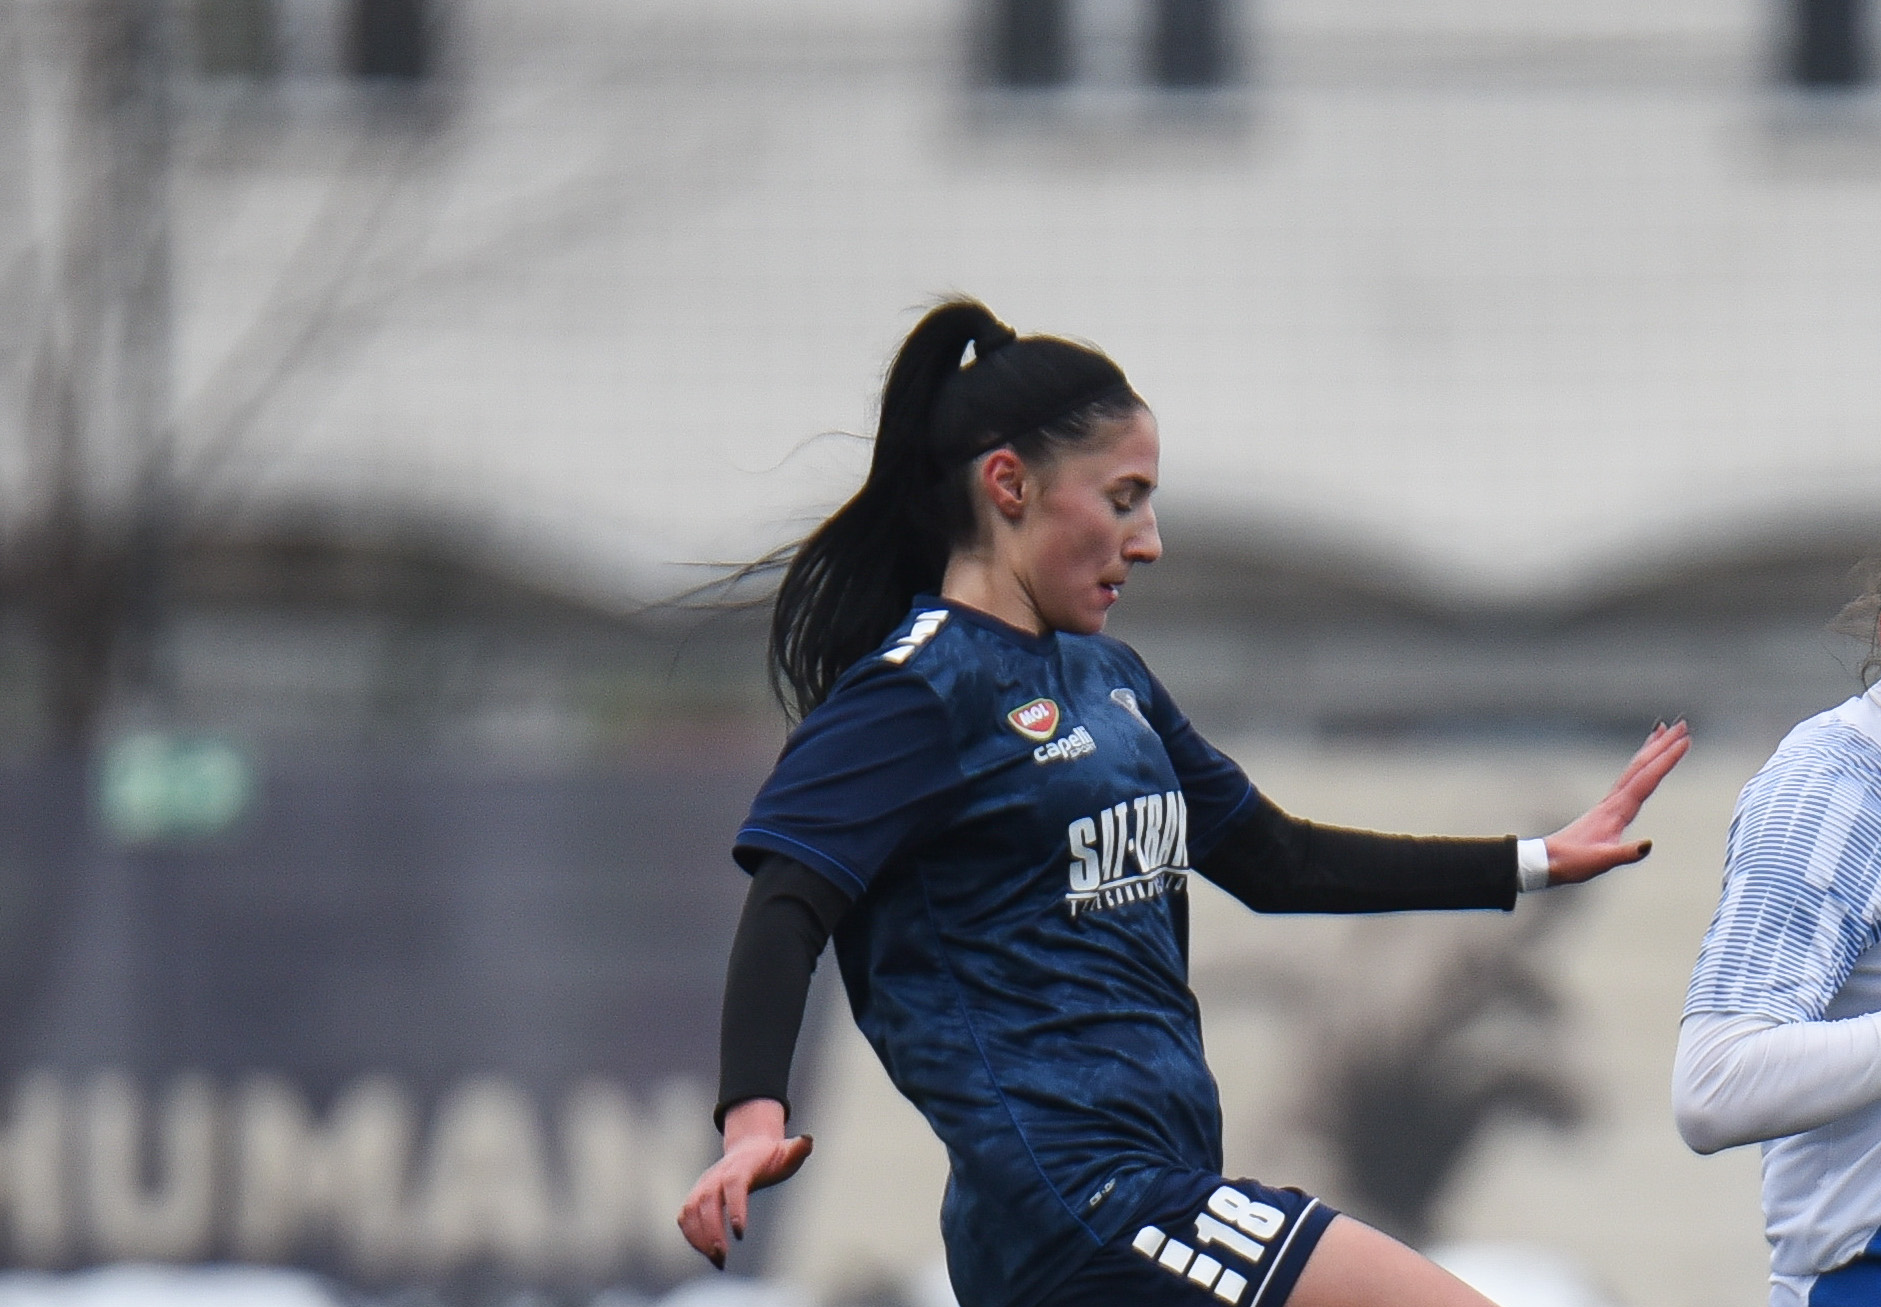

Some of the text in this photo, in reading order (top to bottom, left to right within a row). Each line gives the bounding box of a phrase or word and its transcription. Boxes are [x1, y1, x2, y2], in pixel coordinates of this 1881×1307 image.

[1018, 703, 1050, 727] MOL
[1033, 726, 1095, 762] capelli
[1193, 1185, 1287, 1263] 18
